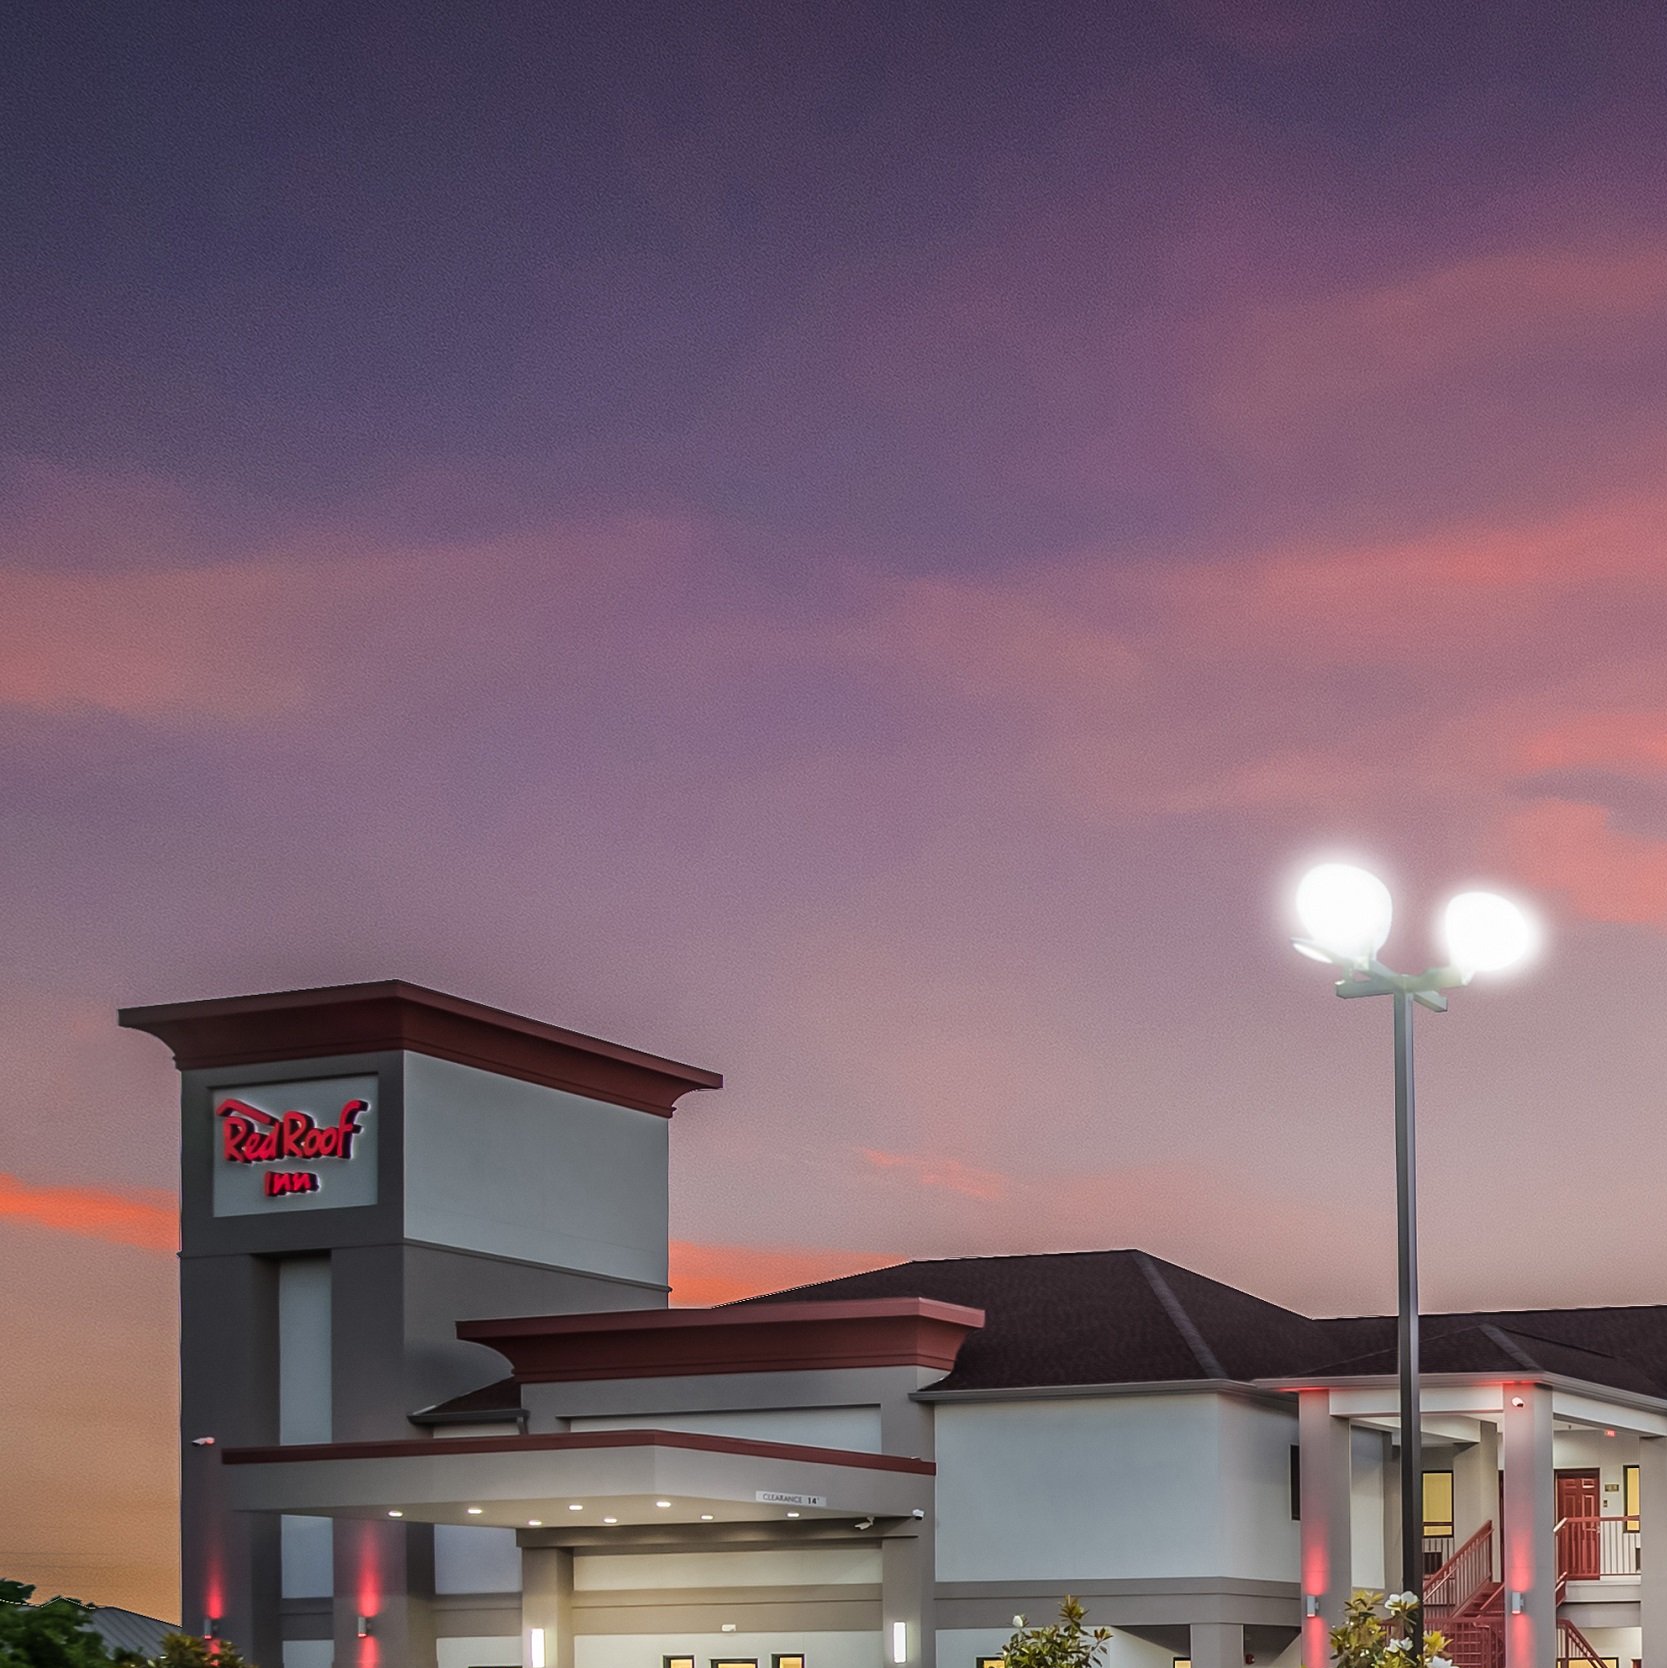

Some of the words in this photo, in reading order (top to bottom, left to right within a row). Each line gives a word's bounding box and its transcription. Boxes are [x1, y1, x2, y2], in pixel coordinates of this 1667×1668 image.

[222, 1114, 283, 1163] Red
[282, 1099, 371, 1160] Roof
[762, 1492, 802, 1504] CLEARANCE
